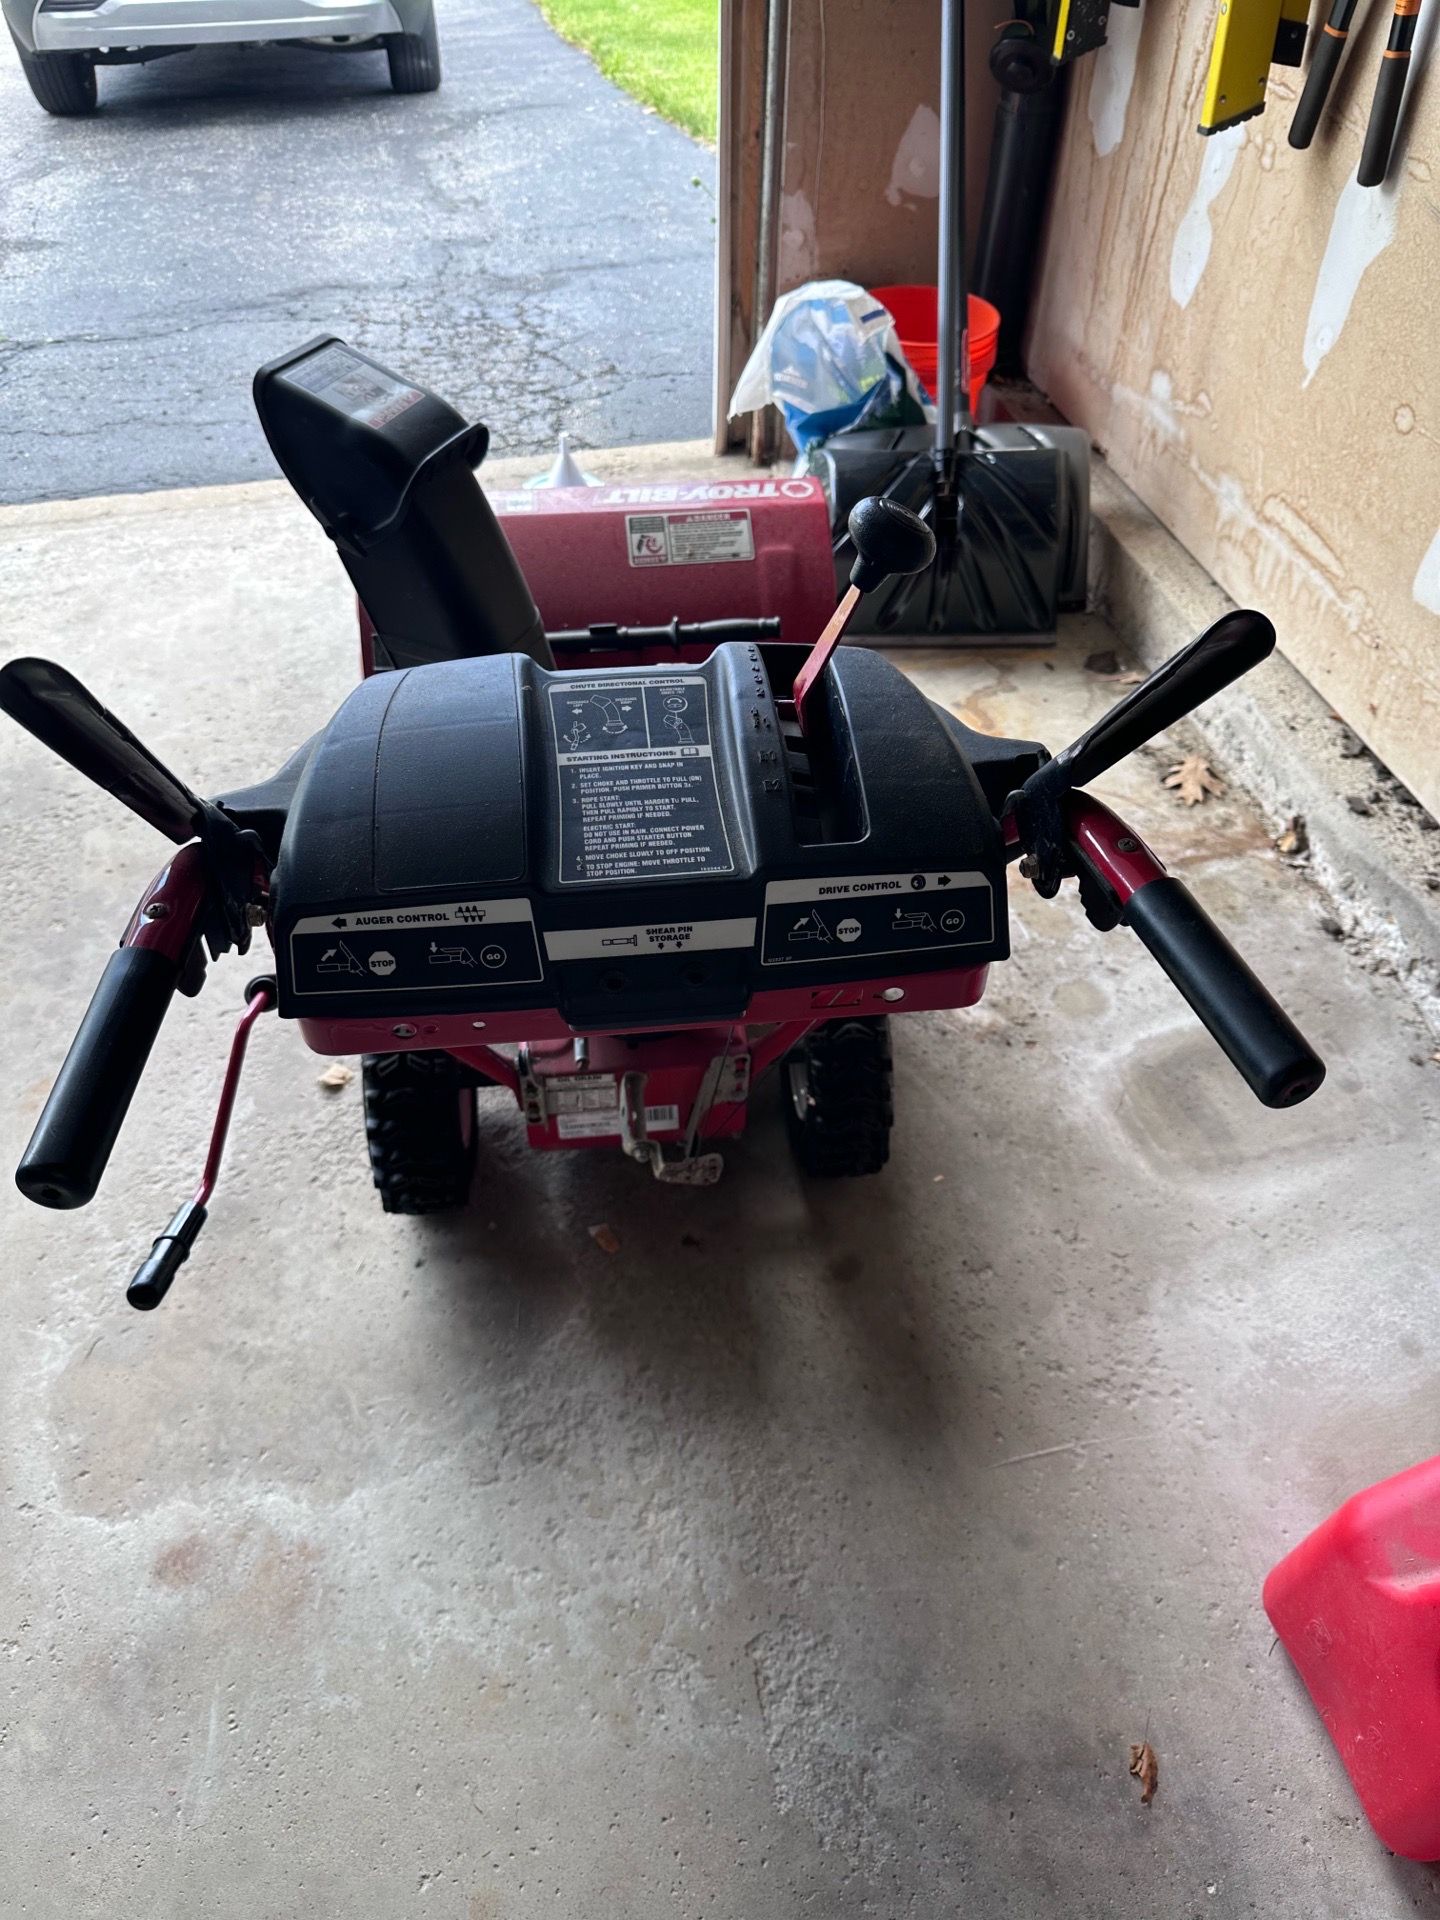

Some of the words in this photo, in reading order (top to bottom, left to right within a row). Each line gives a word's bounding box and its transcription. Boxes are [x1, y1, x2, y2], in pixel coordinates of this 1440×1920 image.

[602, 482, 780, 504] TROY-BILT
[611, 750, 677, 760] INSTRUCTIONS:
[606, 851, 628, 859] CHOKE
[605, 868, 637, 876] POSITION.
[818, 885, 850, 895] DRIVE
[852, 881, 902, 892] CONTROL
[355, 916, 394, 925] AUGER
[396, 913, 450, 923] CONTROL
[946, 917, 960, 925] GO
[646, 927, 675, 935] SHEAR
[838, 927, 860, 935] STOP
[649, 933, 691, 942] STORAGE
[370, 960, 394, 968] STOP
